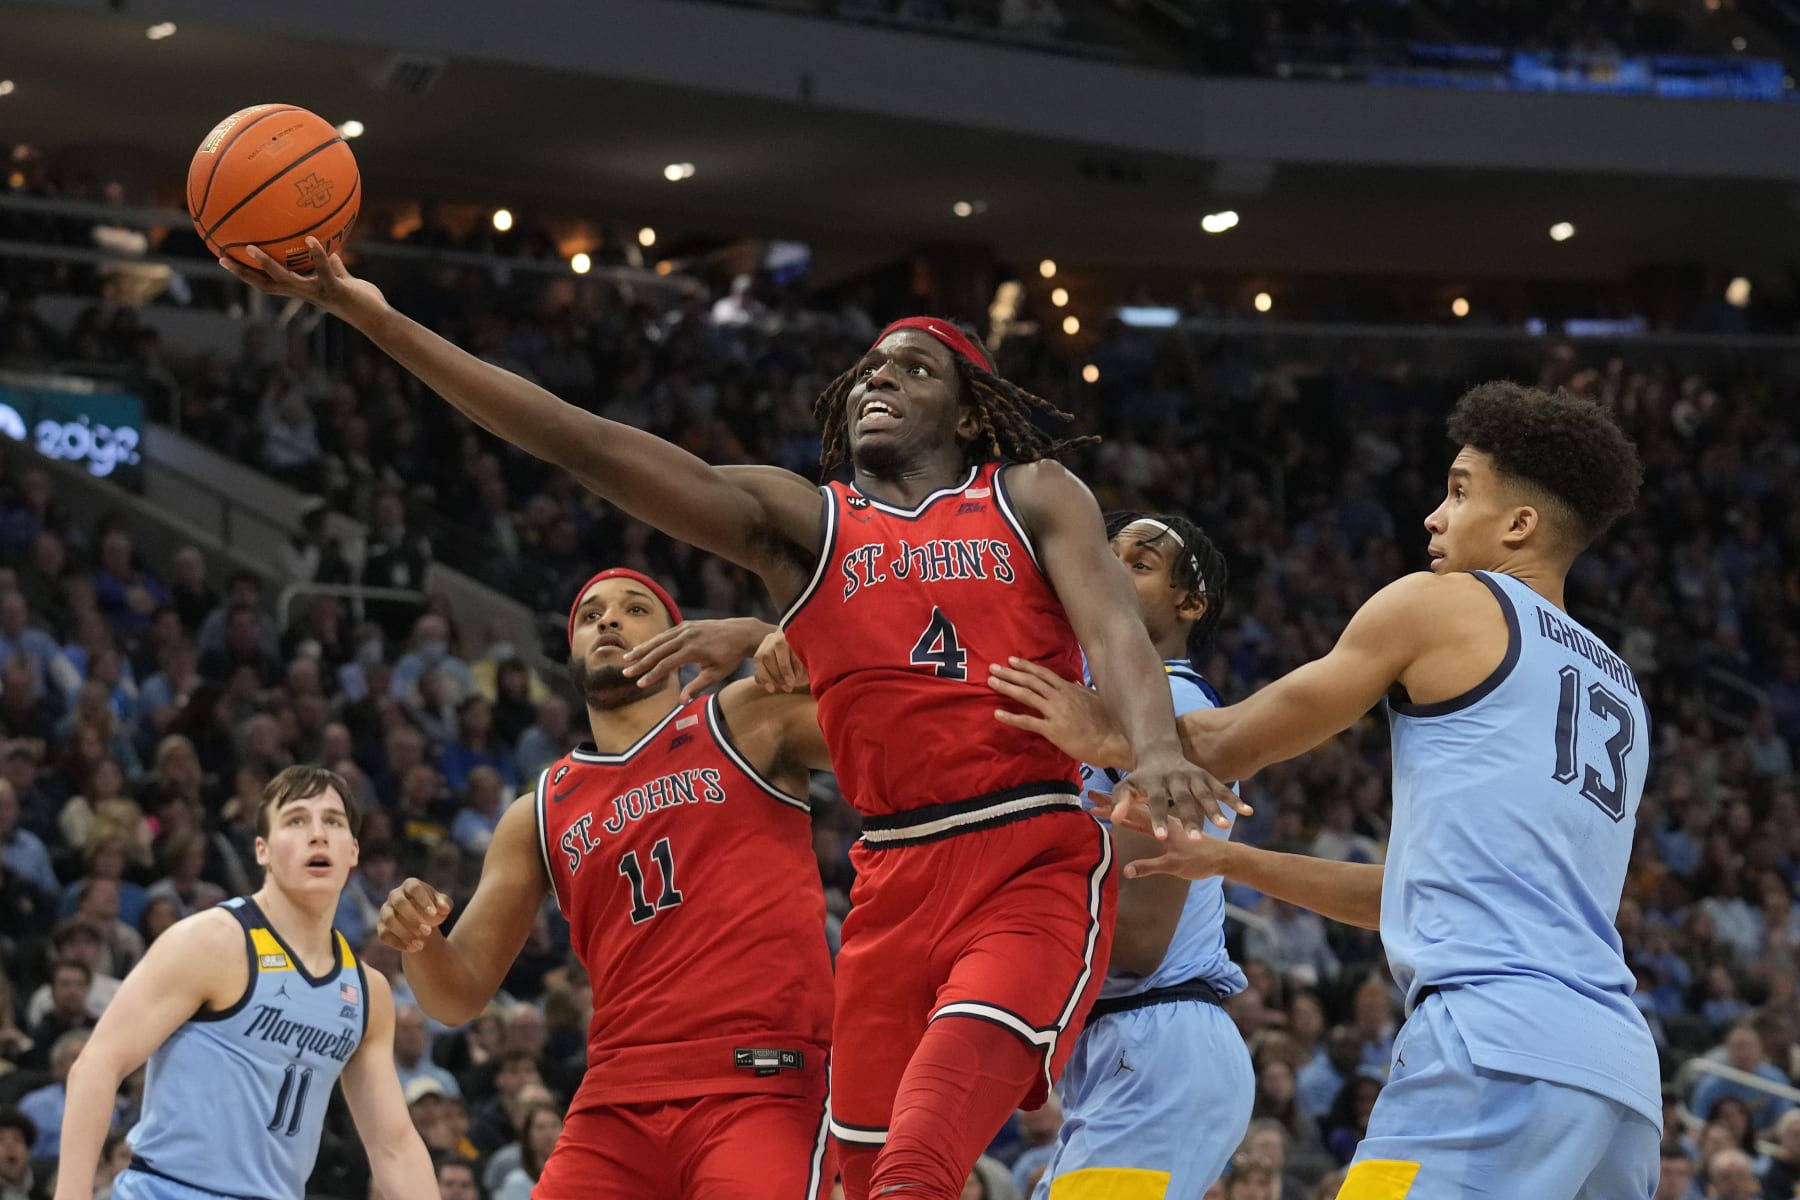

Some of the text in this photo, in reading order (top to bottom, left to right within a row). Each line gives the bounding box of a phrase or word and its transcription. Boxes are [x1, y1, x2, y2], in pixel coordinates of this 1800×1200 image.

[842, 538, 1016, 603] ST. JOHN'S
[910, 605, 968, 682] 4
[1536, 605, 1638, 698] IGHODARO
[1551, 664, 1635, 824] 13
[560, 767, 726, 876] ST. JOHN'S
[618, 836, 684, 925] 11
[243, 1003, 356, 1063] Marquette
[267, 1063, 314, 1137] 11
